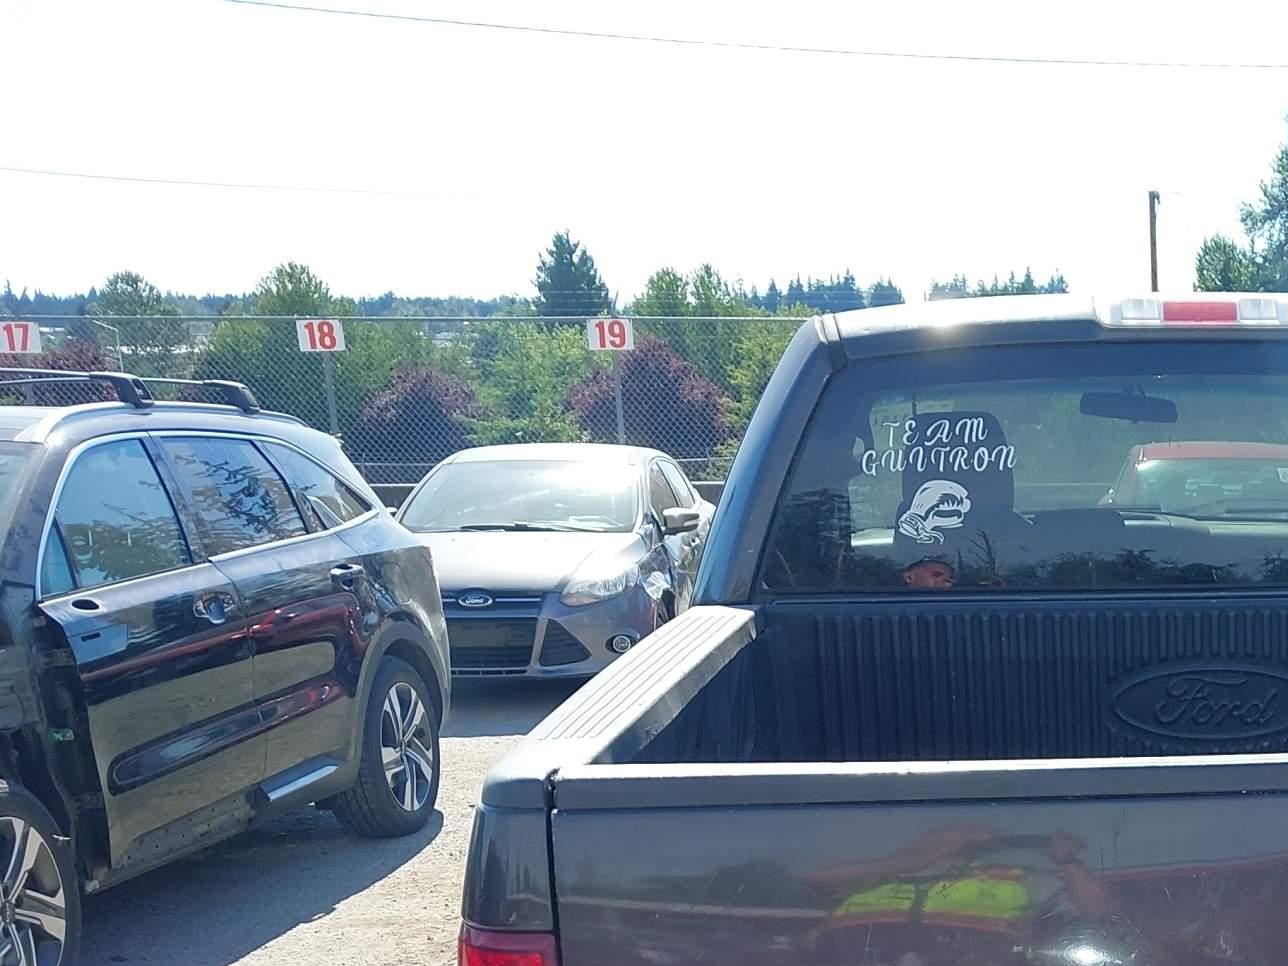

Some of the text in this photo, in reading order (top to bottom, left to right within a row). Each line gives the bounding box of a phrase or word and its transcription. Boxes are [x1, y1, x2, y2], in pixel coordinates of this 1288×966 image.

[3, 323, 29, 351] 17
[304, 321, 336, 349] 18
[595, 319, 626, 348] 19
[882, 417, 988, 448] TEAM
[862, 445, 1018, 477] GUITRON
[1155, 674, 1278, 724] Ford
